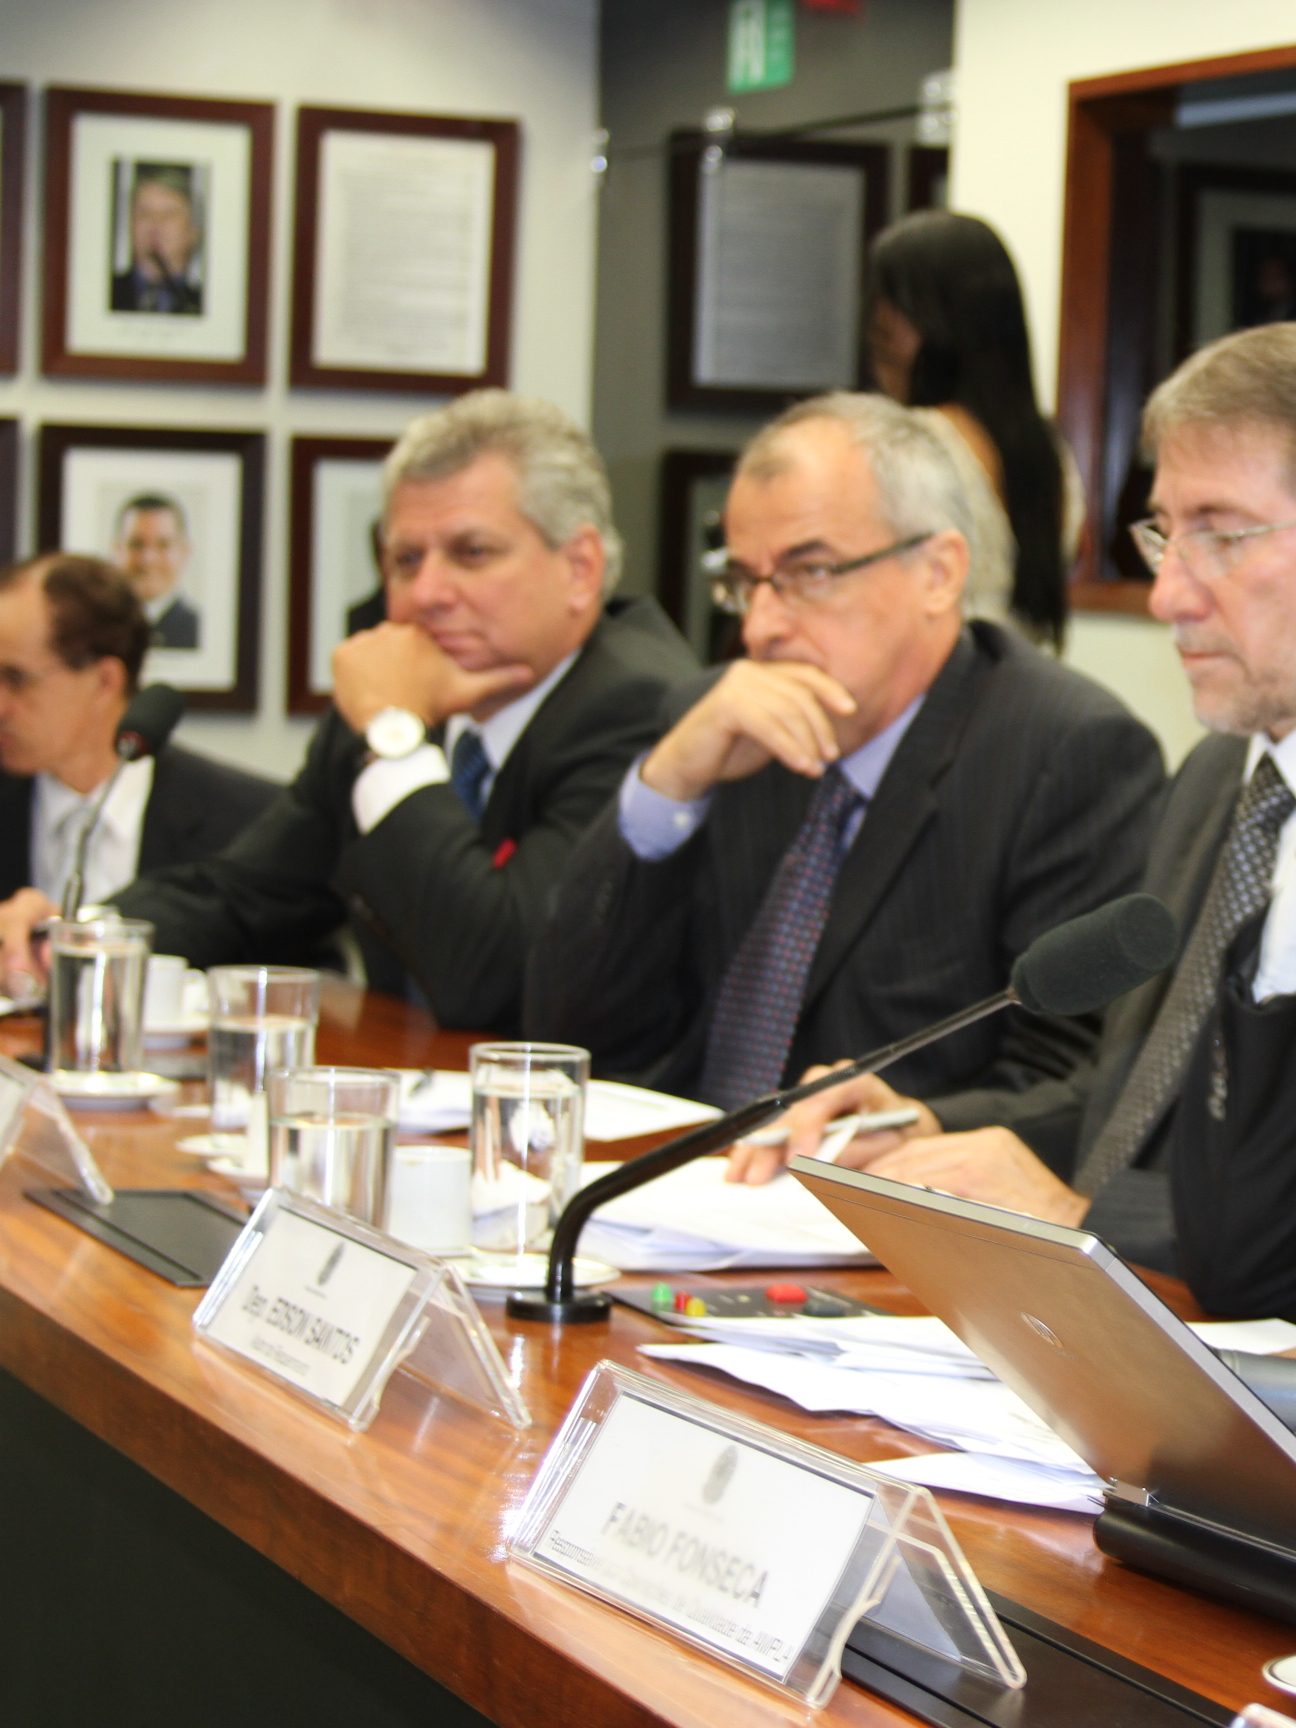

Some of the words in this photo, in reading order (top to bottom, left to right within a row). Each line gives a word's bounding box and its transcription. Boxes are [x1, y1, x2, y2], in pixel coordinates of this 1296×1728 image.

[304, 1317, 363, 1365] SANTOS
[601, 1501, 671, 1558] FABIO
[662, 1529, 770, 1608] FONSECA
[747, 1629, 795, 1666] AMPLA
